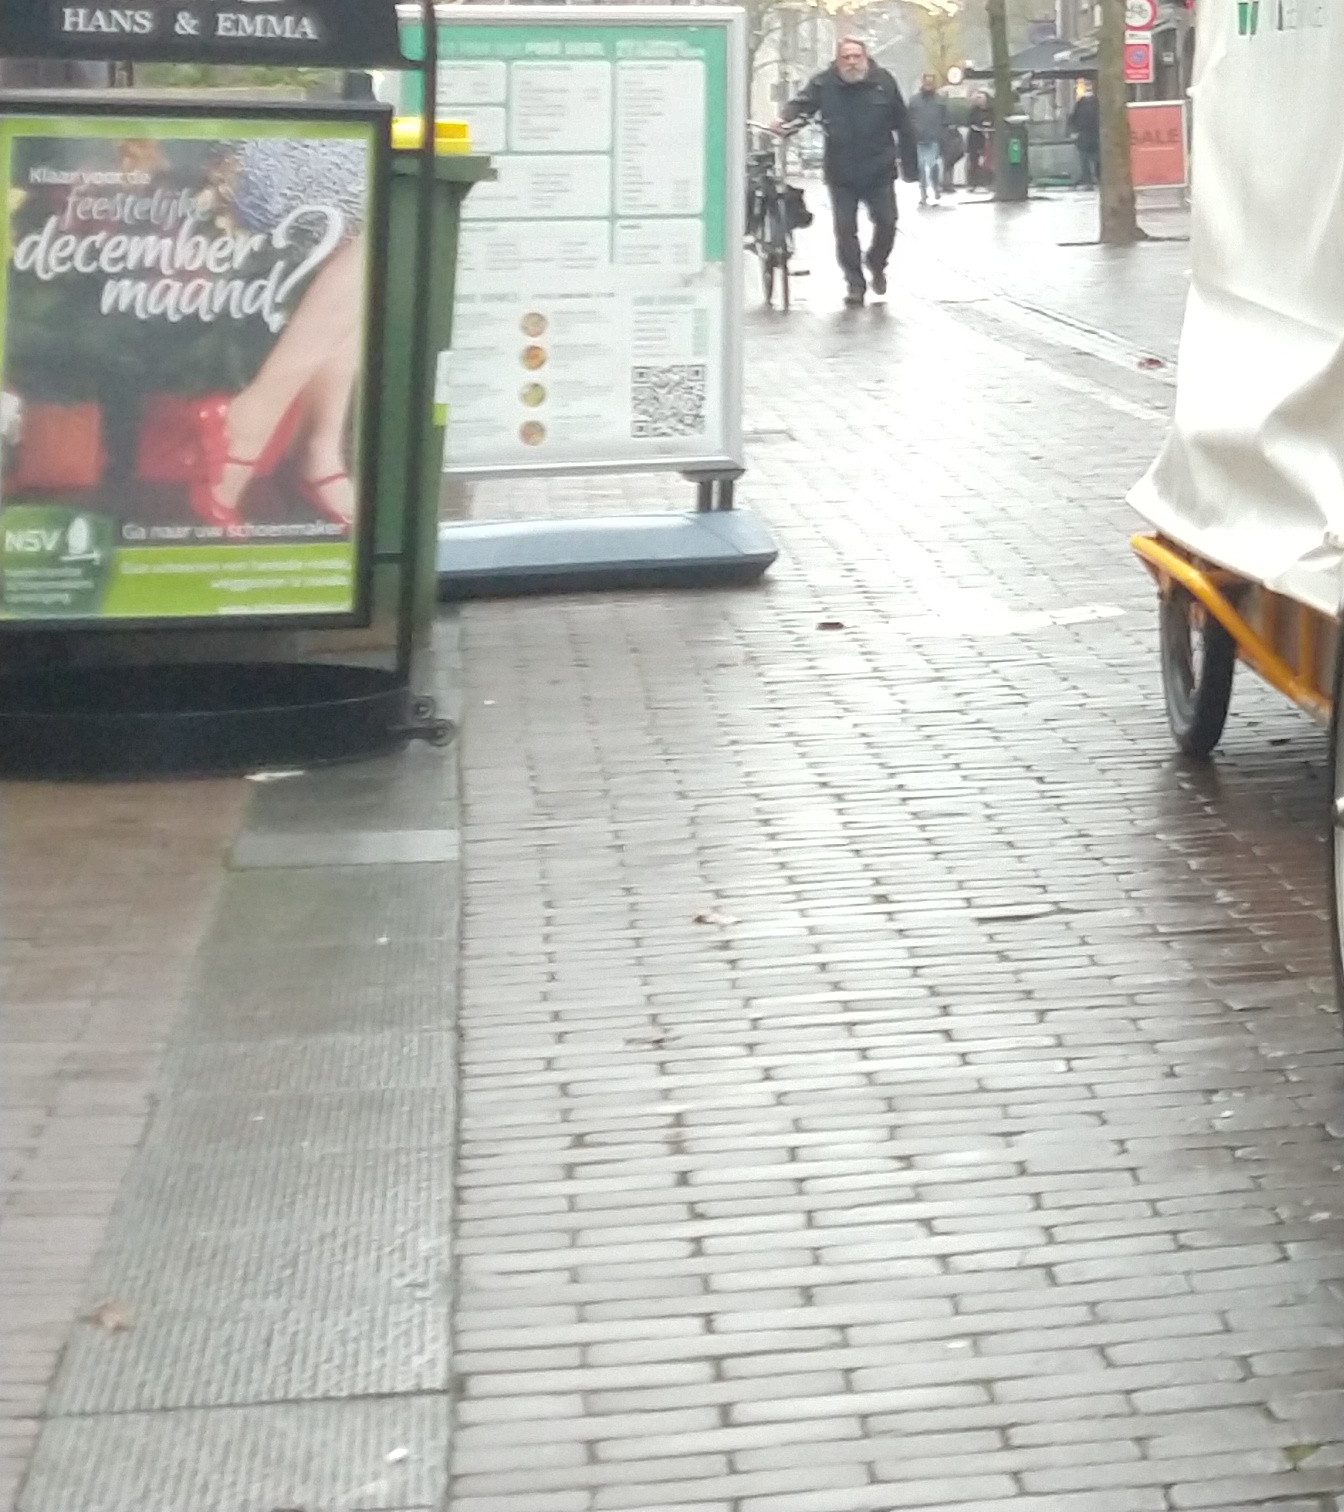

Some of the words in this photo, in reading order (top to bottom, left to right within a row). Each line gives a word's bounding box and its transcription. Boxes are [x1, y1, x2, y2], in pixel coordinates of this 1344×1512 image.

[62, 7, 154, 35] HANS
[174, 10, 200, 36] &
[215, 12, 320, 40] EMMA
[61, 185, 213, 231] feestelijke
[13, 214, 269, 282] december
[4, 528, 63, 553] NSV
